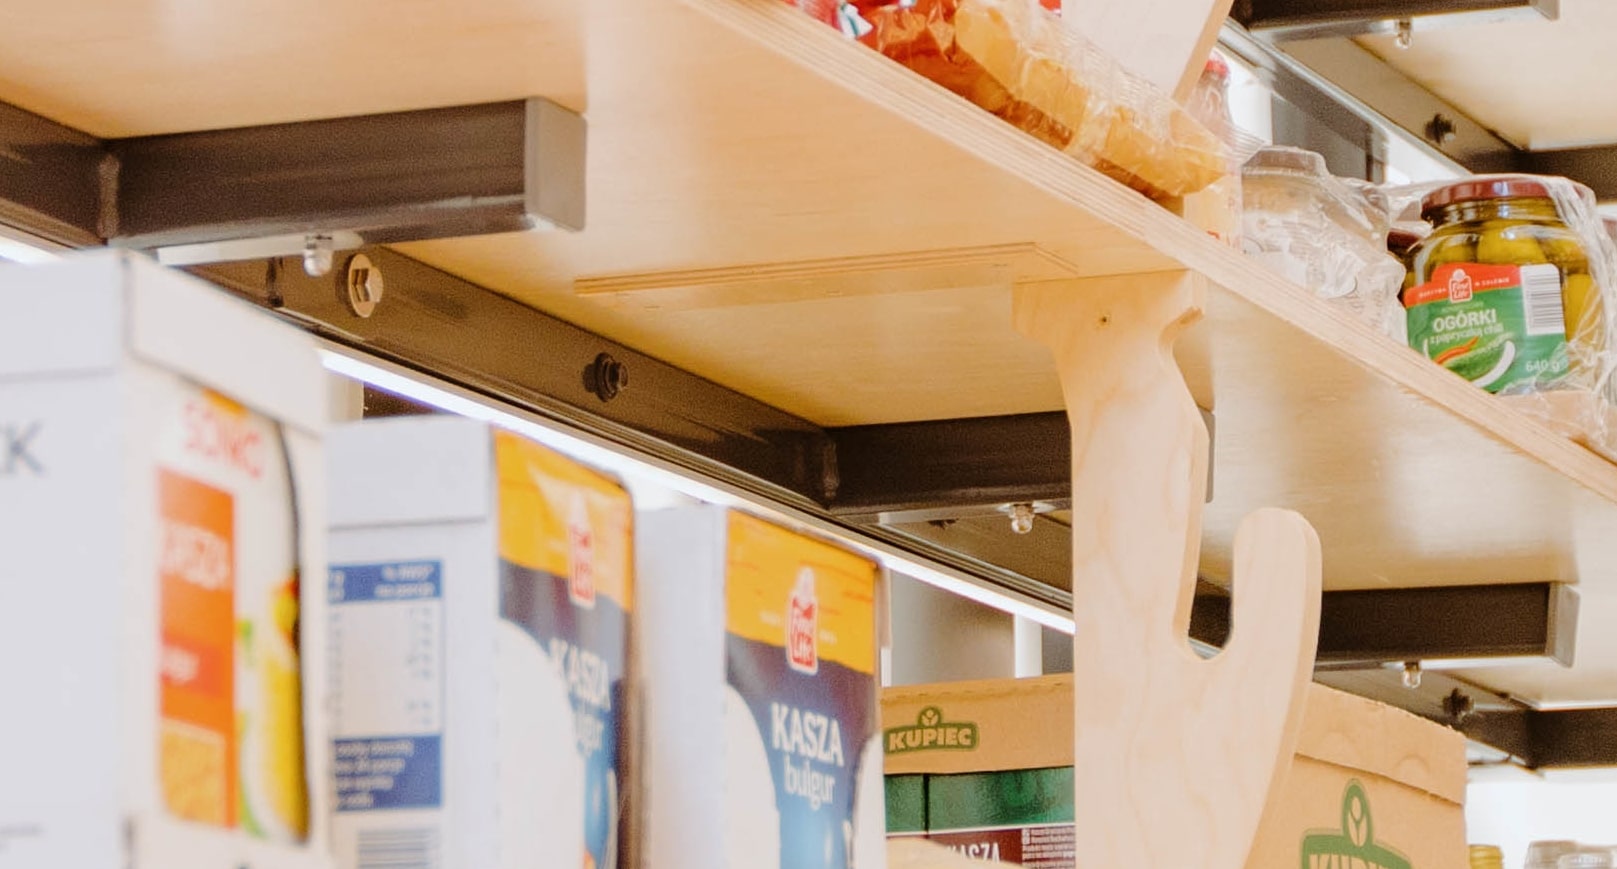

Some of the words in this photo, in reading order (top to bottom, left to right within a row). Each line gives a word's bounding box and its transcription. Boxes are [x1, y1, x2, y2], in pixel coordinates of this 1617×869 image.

[1432, 308, 1497, 333] OGÓRKI
[1525, 359, 1549, 373] 640
[0, 419, 46, 478] K
[771, 701, 844, 768] KASZA
[888, 728, 973, 752] KUPIEC
[784, 750, 836, 811] bulgur
